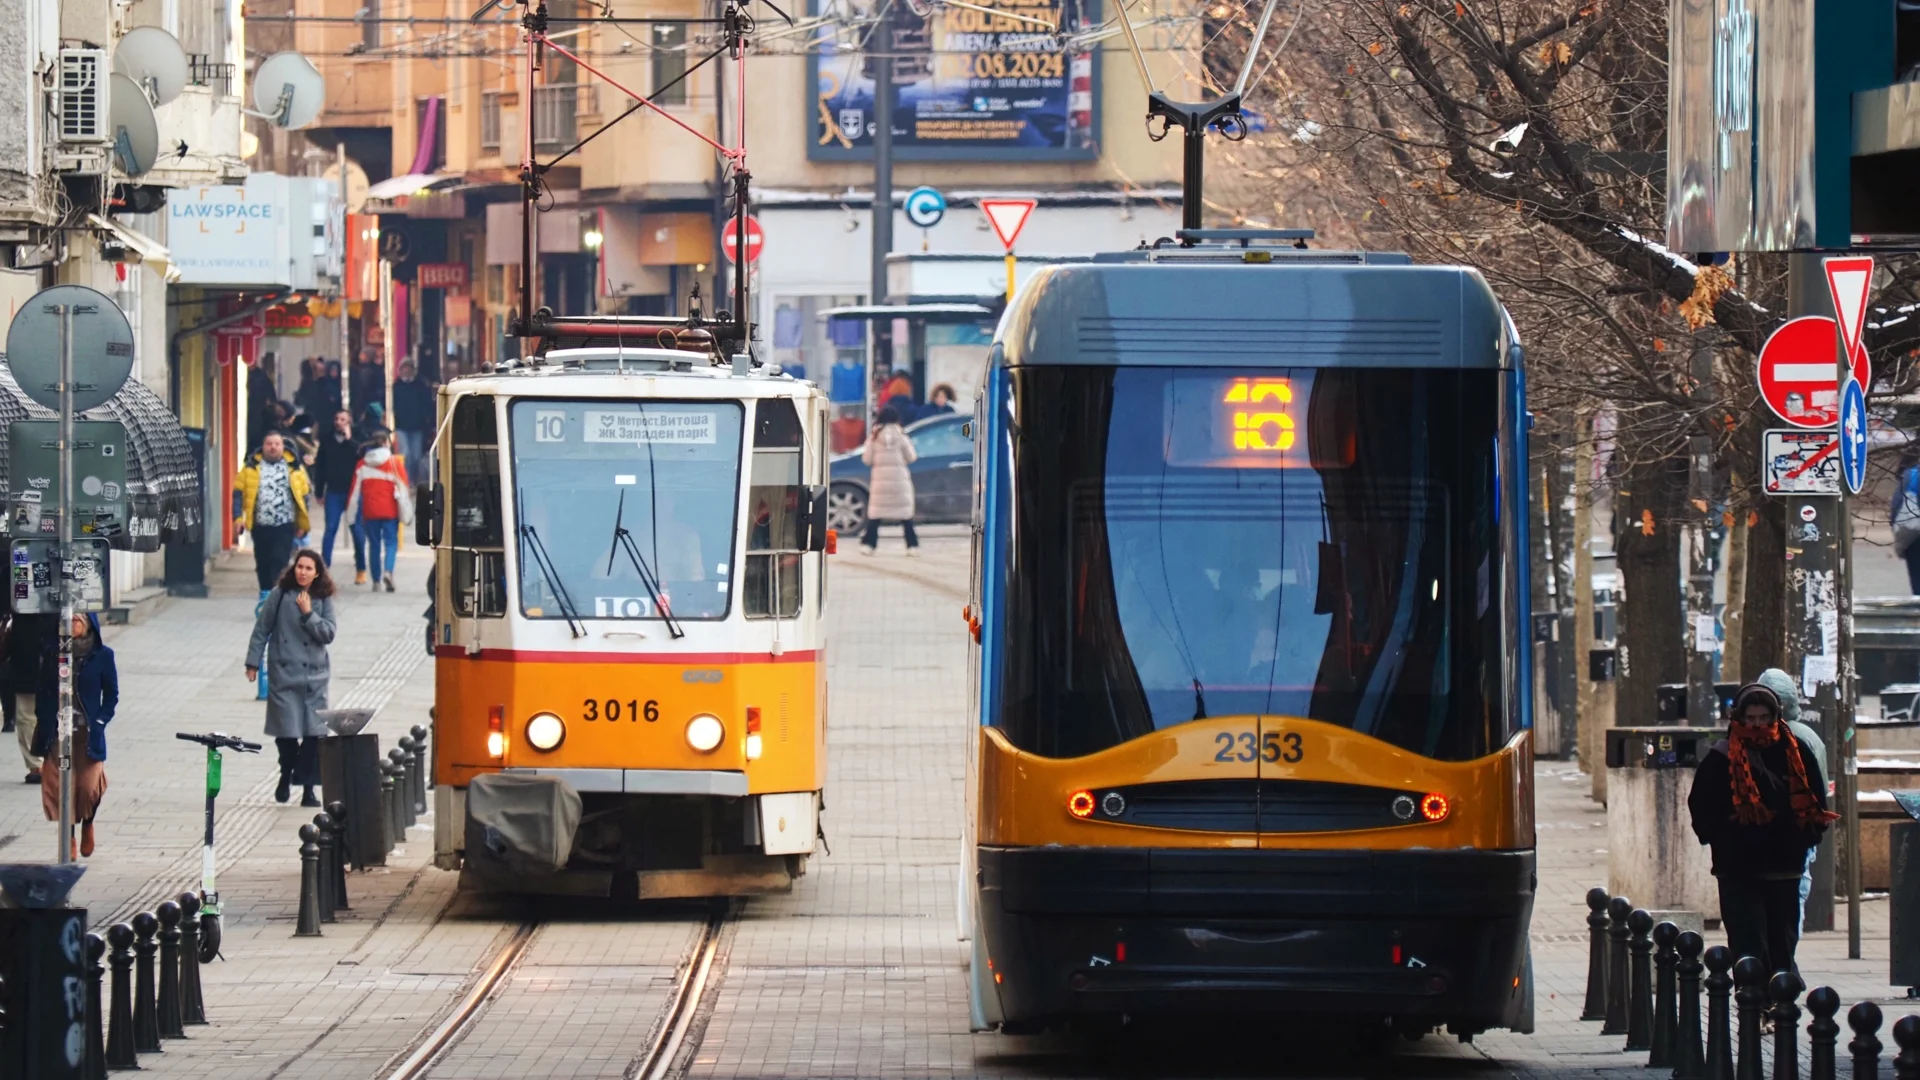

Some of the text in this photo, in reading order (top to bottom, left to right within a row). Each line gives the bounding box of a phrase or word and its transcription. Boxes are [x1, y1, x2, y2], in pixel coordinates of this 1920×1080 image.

[173, 204, 272, 218] LAWSPACE
[424, 266, 464, 284] BBQ
[537, 416, 565, 439] 10
[619, 428, 674, 440] Западен
[677, 428, 708, 440] парк
[601, 598, 647, 617] 10
[583, 699, 659, 722] 3016
[1215, 732, 1303, 763] 2353
